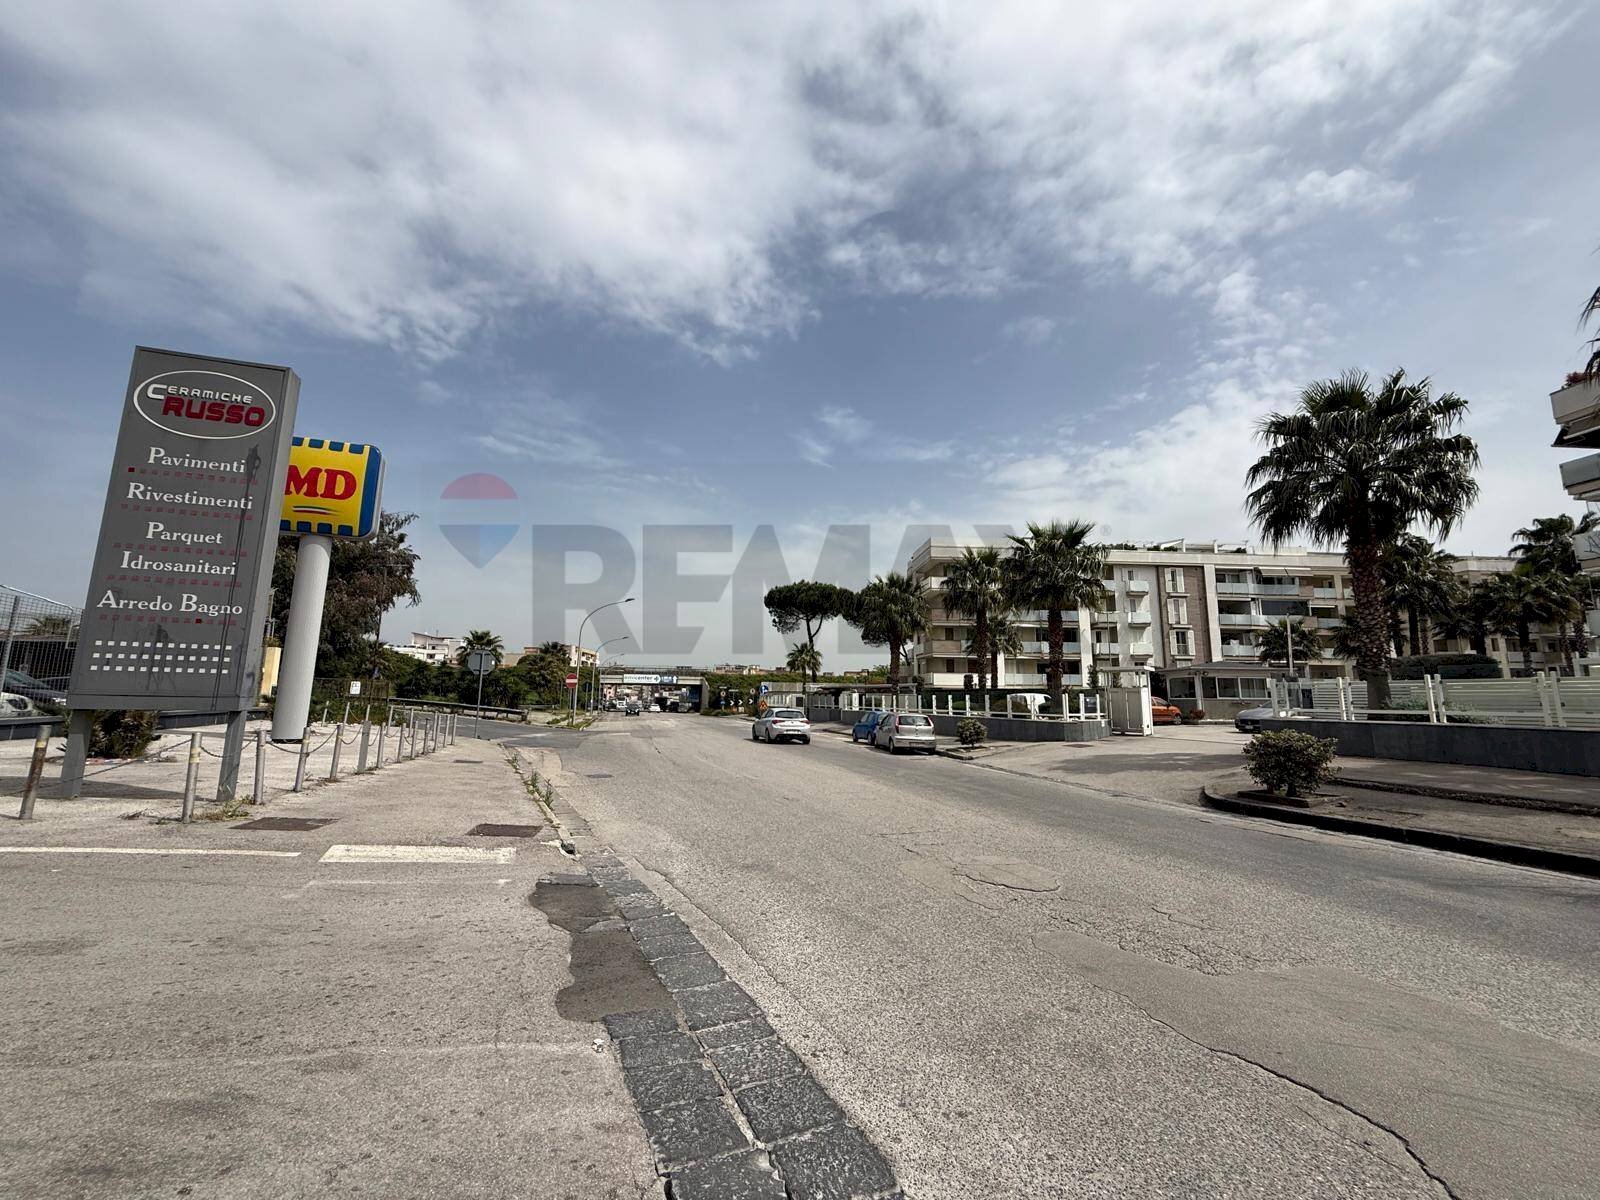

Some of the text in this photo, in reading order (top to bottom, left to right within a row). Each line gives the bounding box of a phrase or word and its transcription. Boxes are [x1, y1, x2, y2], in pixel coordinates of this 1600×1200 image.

[147, 383, 253, 404] CERAMICHE
[162, 396, 265, 427] RUSSO
[147, 446, 246, 473] Pavimenti
[126, 482, 253, 510] Rivestimenti
[284, 464, 357, 501] MD
[145, 521, 223, 545] Parquet
[120, 550, 236, 576] Idrosanitari
[96, 589, 243, 617] Arredo Bagno
